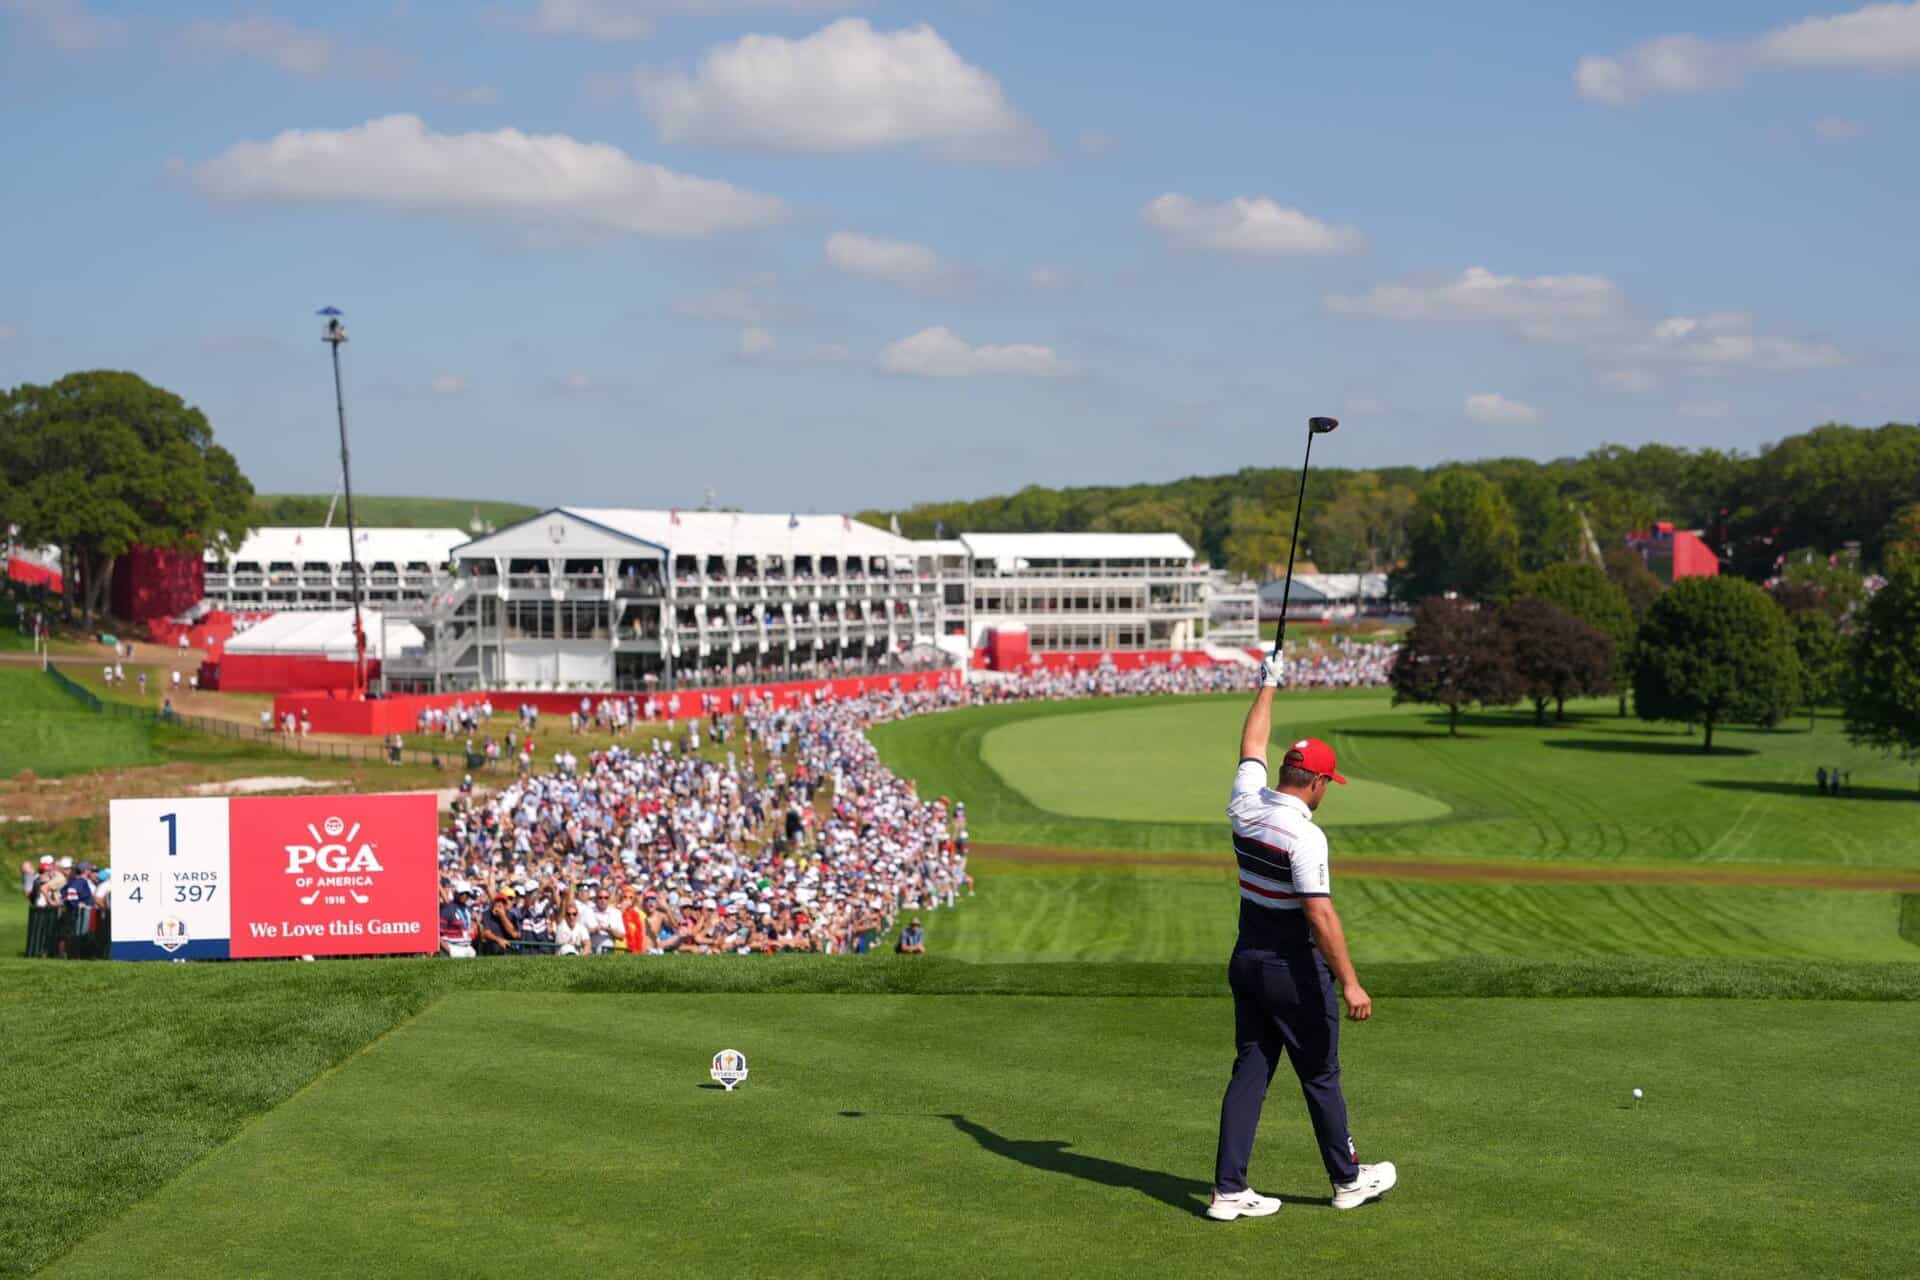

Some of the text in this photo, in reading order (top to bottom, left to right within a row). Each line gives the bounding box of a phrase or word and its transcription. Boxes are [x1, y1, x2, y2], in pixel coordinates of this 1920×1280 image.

[159, 813, 176, 856] 1
[285, 844, 384, 874] PGA
[123, 873, 150, 883] PAR
[173, 872, 217, 881] YARDS
[296, 876, 373, 888] OF AMERICA
[128, 886, 144, 904] 4
[174, 885, 217, 902] 397
[249, 919, 421, 938] We Love this Game
